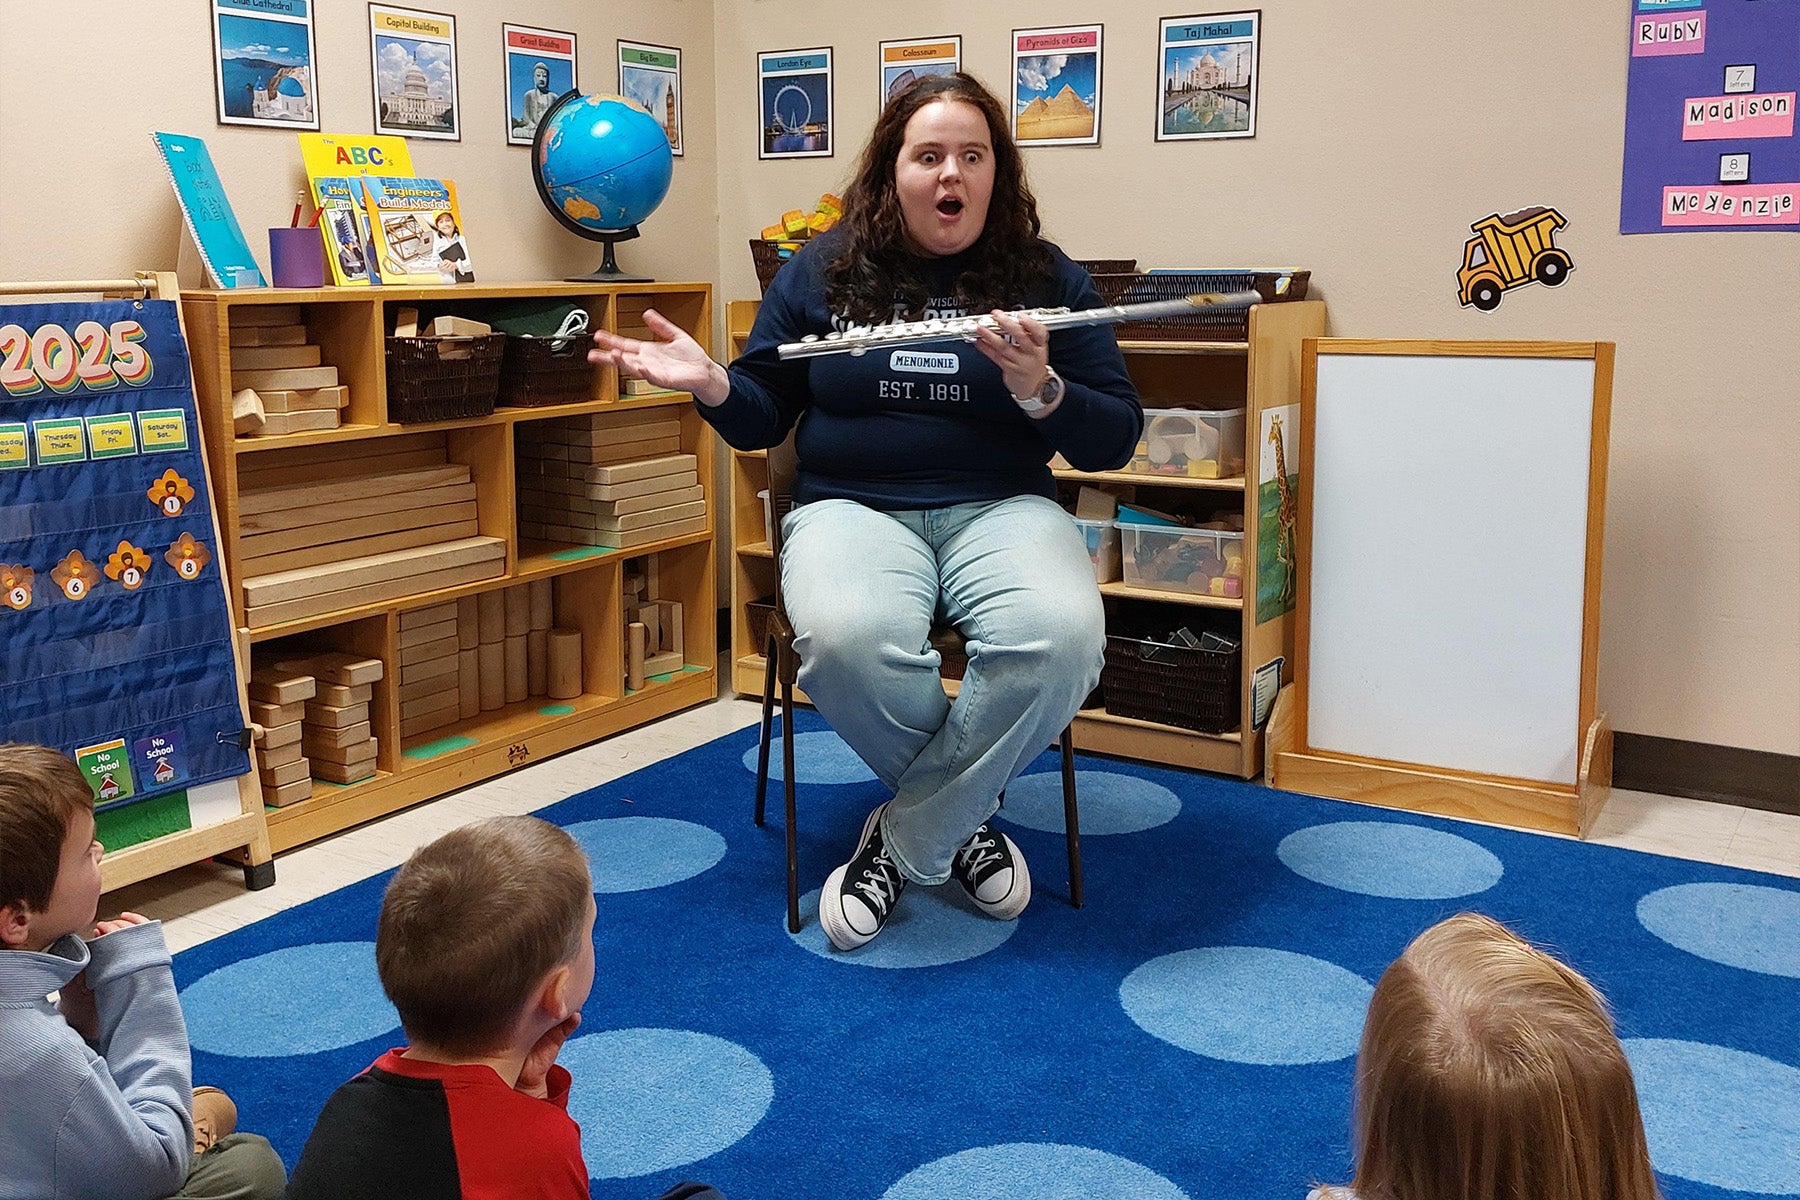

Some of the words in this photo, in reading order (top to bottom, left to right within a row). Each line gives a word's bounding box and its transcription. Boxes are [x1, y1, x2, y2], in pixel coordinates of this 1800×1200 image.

[386, 16, 411, 28] Capitol
[413, 20, 439, 34] Building
[1184, 27, 1200, 39] Taj
[1203, 25, 1232, 37] Mahal
[538, 38, 560, 49] Buddha
[1026, 36, 1060, 49] Pyramids
[1061, 37, 1069, 45] of
[1071, 35, 1088, 44] Giza
[639, 52, 648, 62] Big
[649, 54, 659, 63] Ben
[902, 48, 937, 57] Colosseum
[777, 60, 799, 68] London
[800, 58, 811, 67] Eye
[1736, 70, 1745, 81] 7
[1690, 98, 1787, 121] Madison
[336, 146, 394, 166] ABC's
[1730, 158, 1738, 170] 8
[382, 185, 442, 198] Engineers
[336, 200, 351, 209] Fin
[379, 196, 408, 209] Build
[410, 198, 452, 210] Models
[0, 320, 154, 397] 2025
[895, 355, 955, 369] MENOMONIE
[879, 380, 920, 400] EST.
[929, 383, 970, 402] 1891
[147, 423, 178, 431] Saturday
[44, 433, 77, 441] Thursday
[169, 500, 175, 510] 1
[185, 562, 193, 573] 8
[127, 572, 135, 582] 7
[72, 582, 79, 593] 6
[15, 591, 23, 602] 5
[151, 738, 165, 748] No
[146, 744, 174, 759] School
[97, 753, 111, 763] No
[90, 760, 120, 775] School
